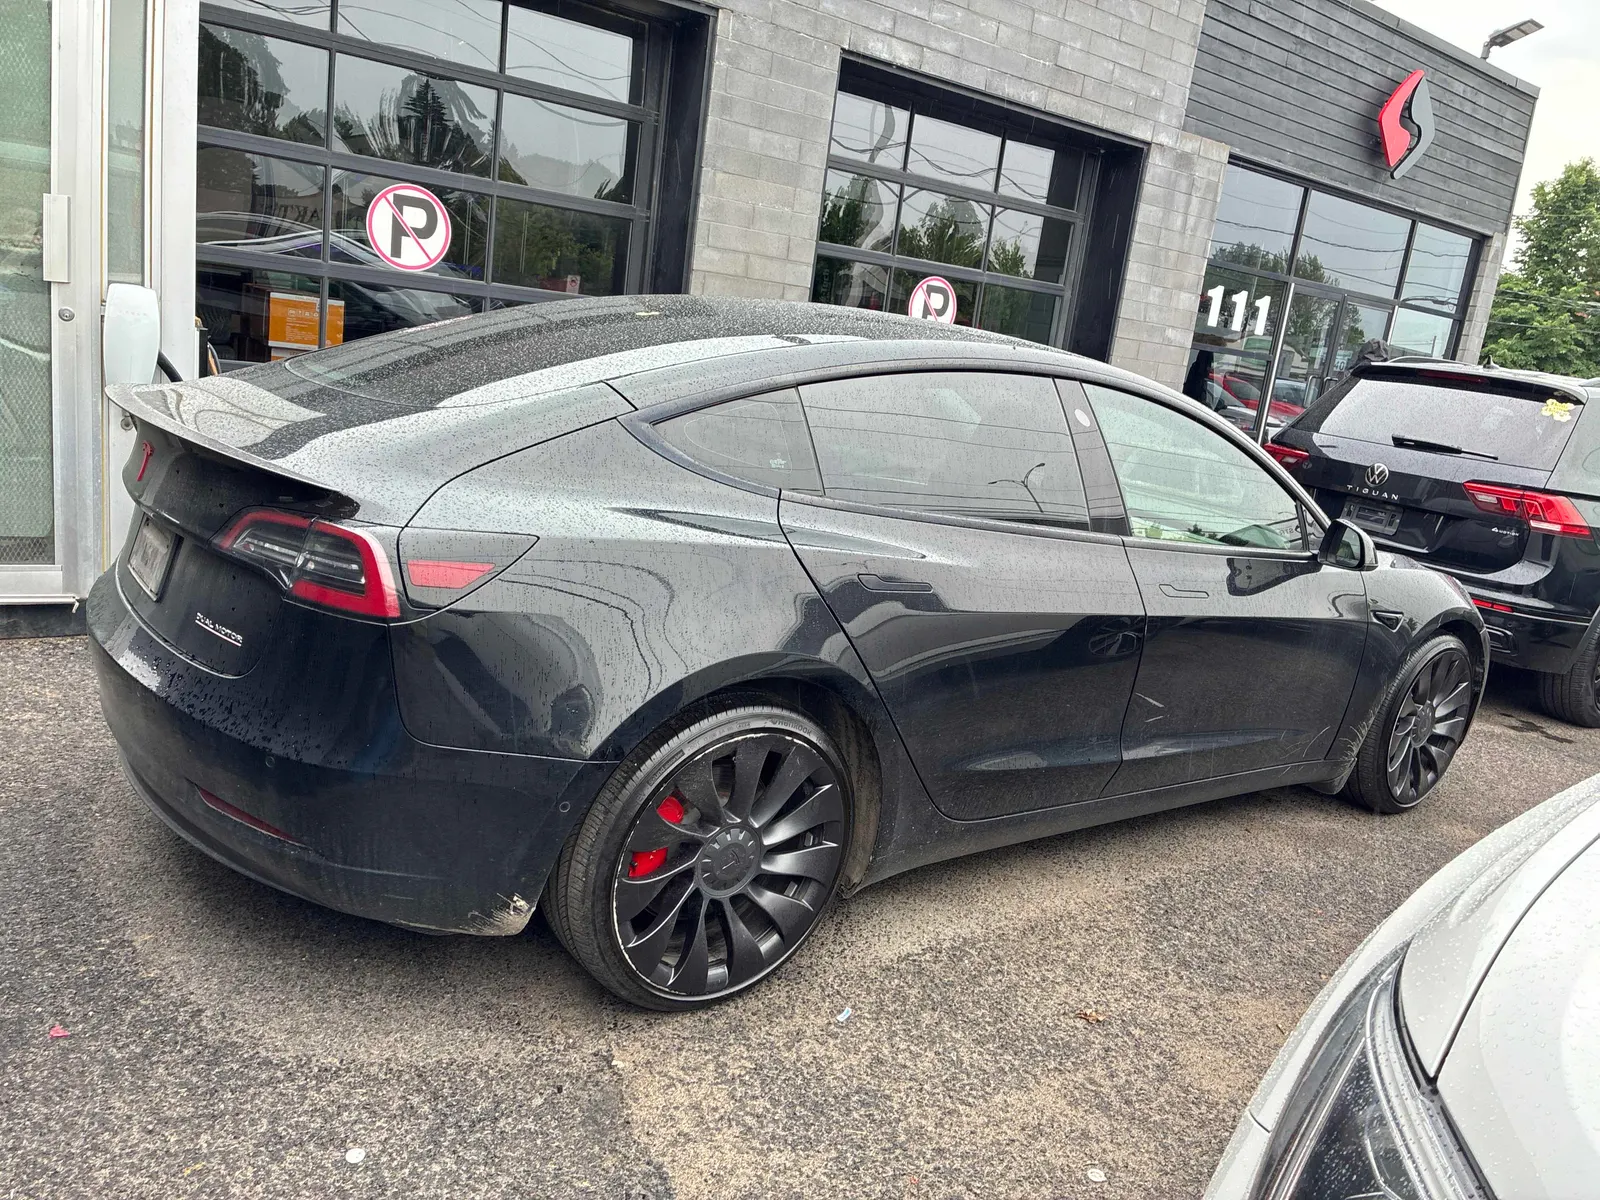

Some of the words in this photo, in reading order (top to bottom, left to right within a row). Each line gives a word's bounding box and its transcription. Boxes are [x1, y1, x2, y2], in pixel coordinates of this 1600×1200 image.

[390, 193, 438, 258] P
[922, 284, 949, 319] P
[1207, 284, 1271, 336] 111
[1346, 484, 1399, 500] TIGUAN
[196, 612, 214, 628] DUAL
[215, 623, 243, 643] MOTOR
